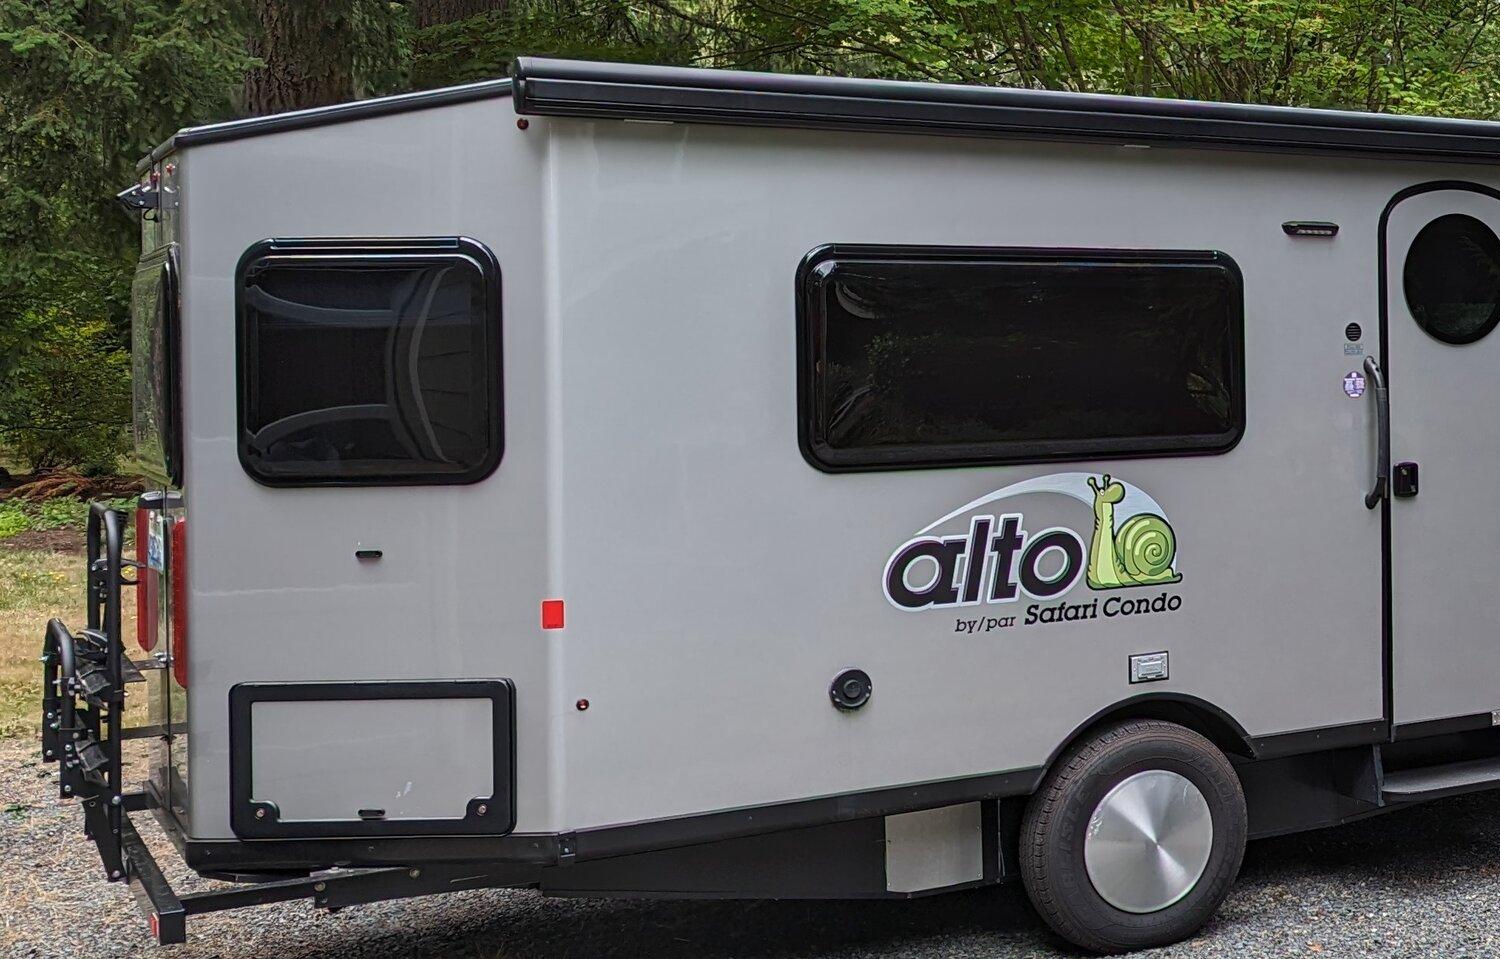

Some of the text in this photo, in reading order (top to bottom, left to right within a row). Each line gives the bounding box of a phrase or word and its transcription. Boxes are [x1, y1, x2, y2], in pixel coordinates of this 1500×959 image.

[883, 515, 1085, 610] alto
[954, 592, 1182, 633] by/par Safari Condo
